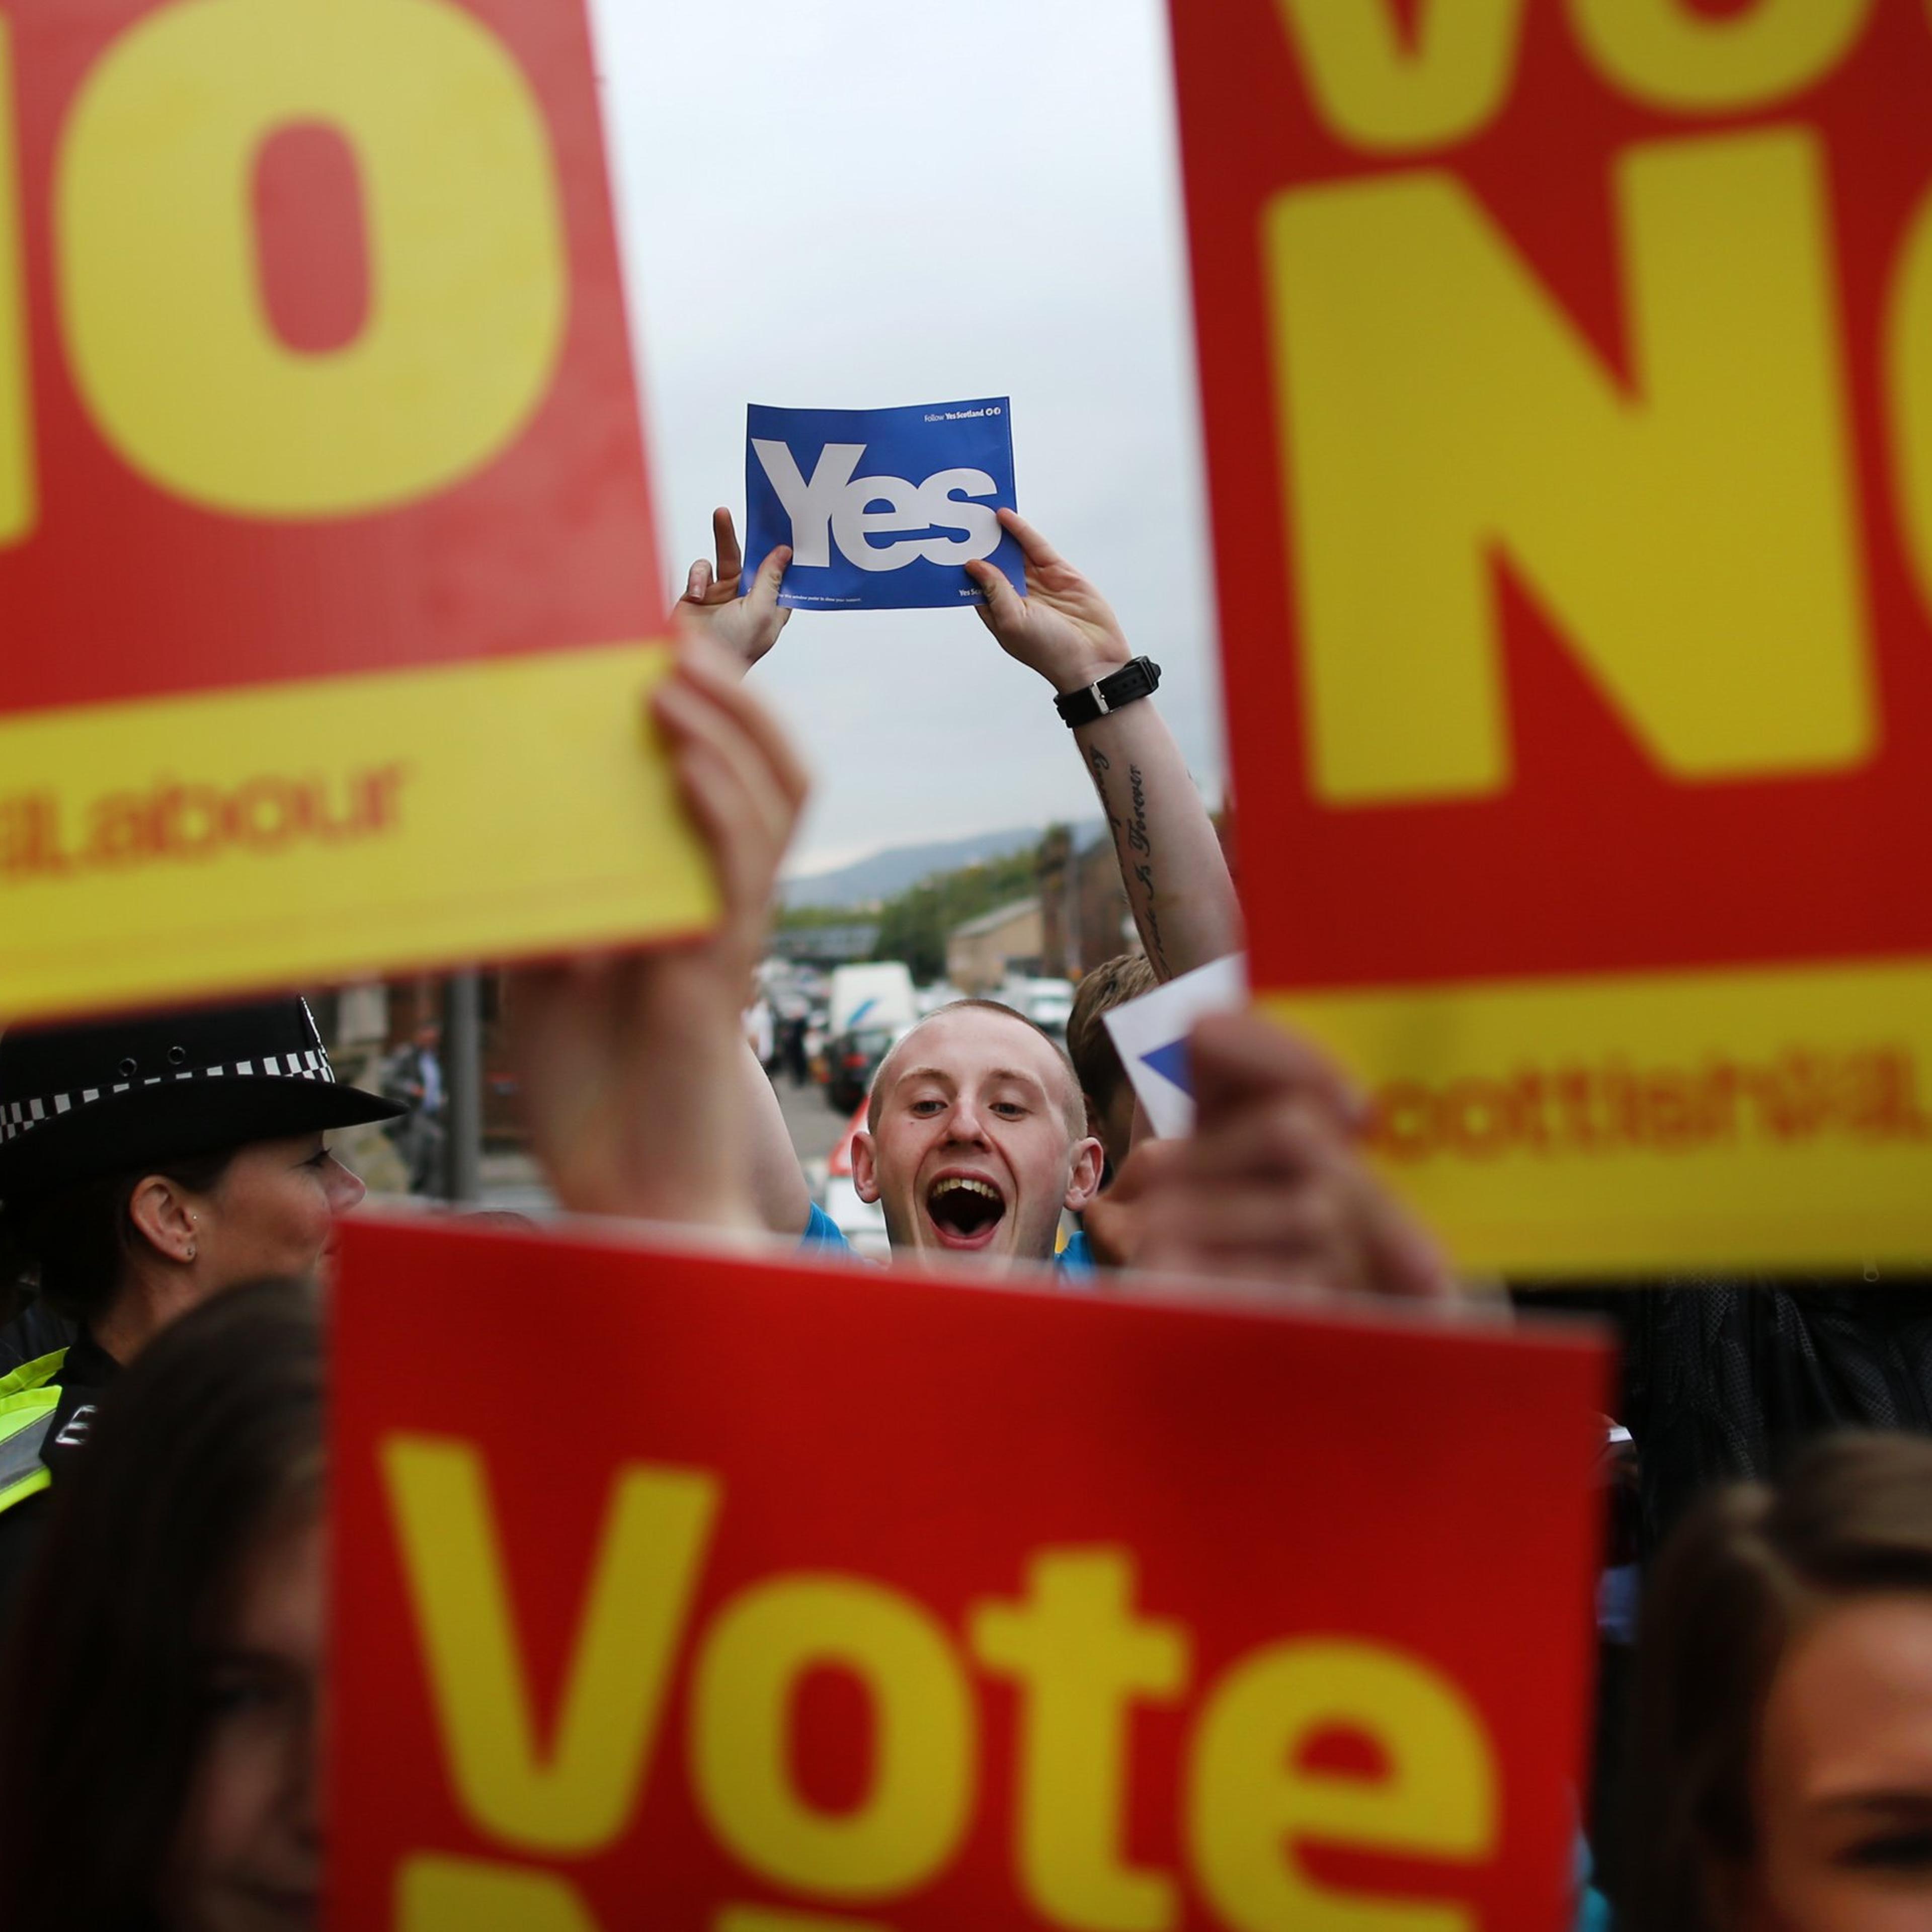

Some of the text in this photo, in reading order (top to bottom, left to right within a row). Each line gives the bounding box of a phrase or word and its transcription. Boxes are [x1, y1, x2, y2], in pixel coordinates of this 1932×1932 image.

[0, 0, 568, 547] O
[924, 414, 944, 422] Follow
[1264, 118, 1932, 808] N
[751, 437, 1002, 572] Yes
[1126, 763, 1151, 857] Forever
[1361, 1049, 1779, 1166] cottish
[380, 1434, 1503, 1932] Vote
